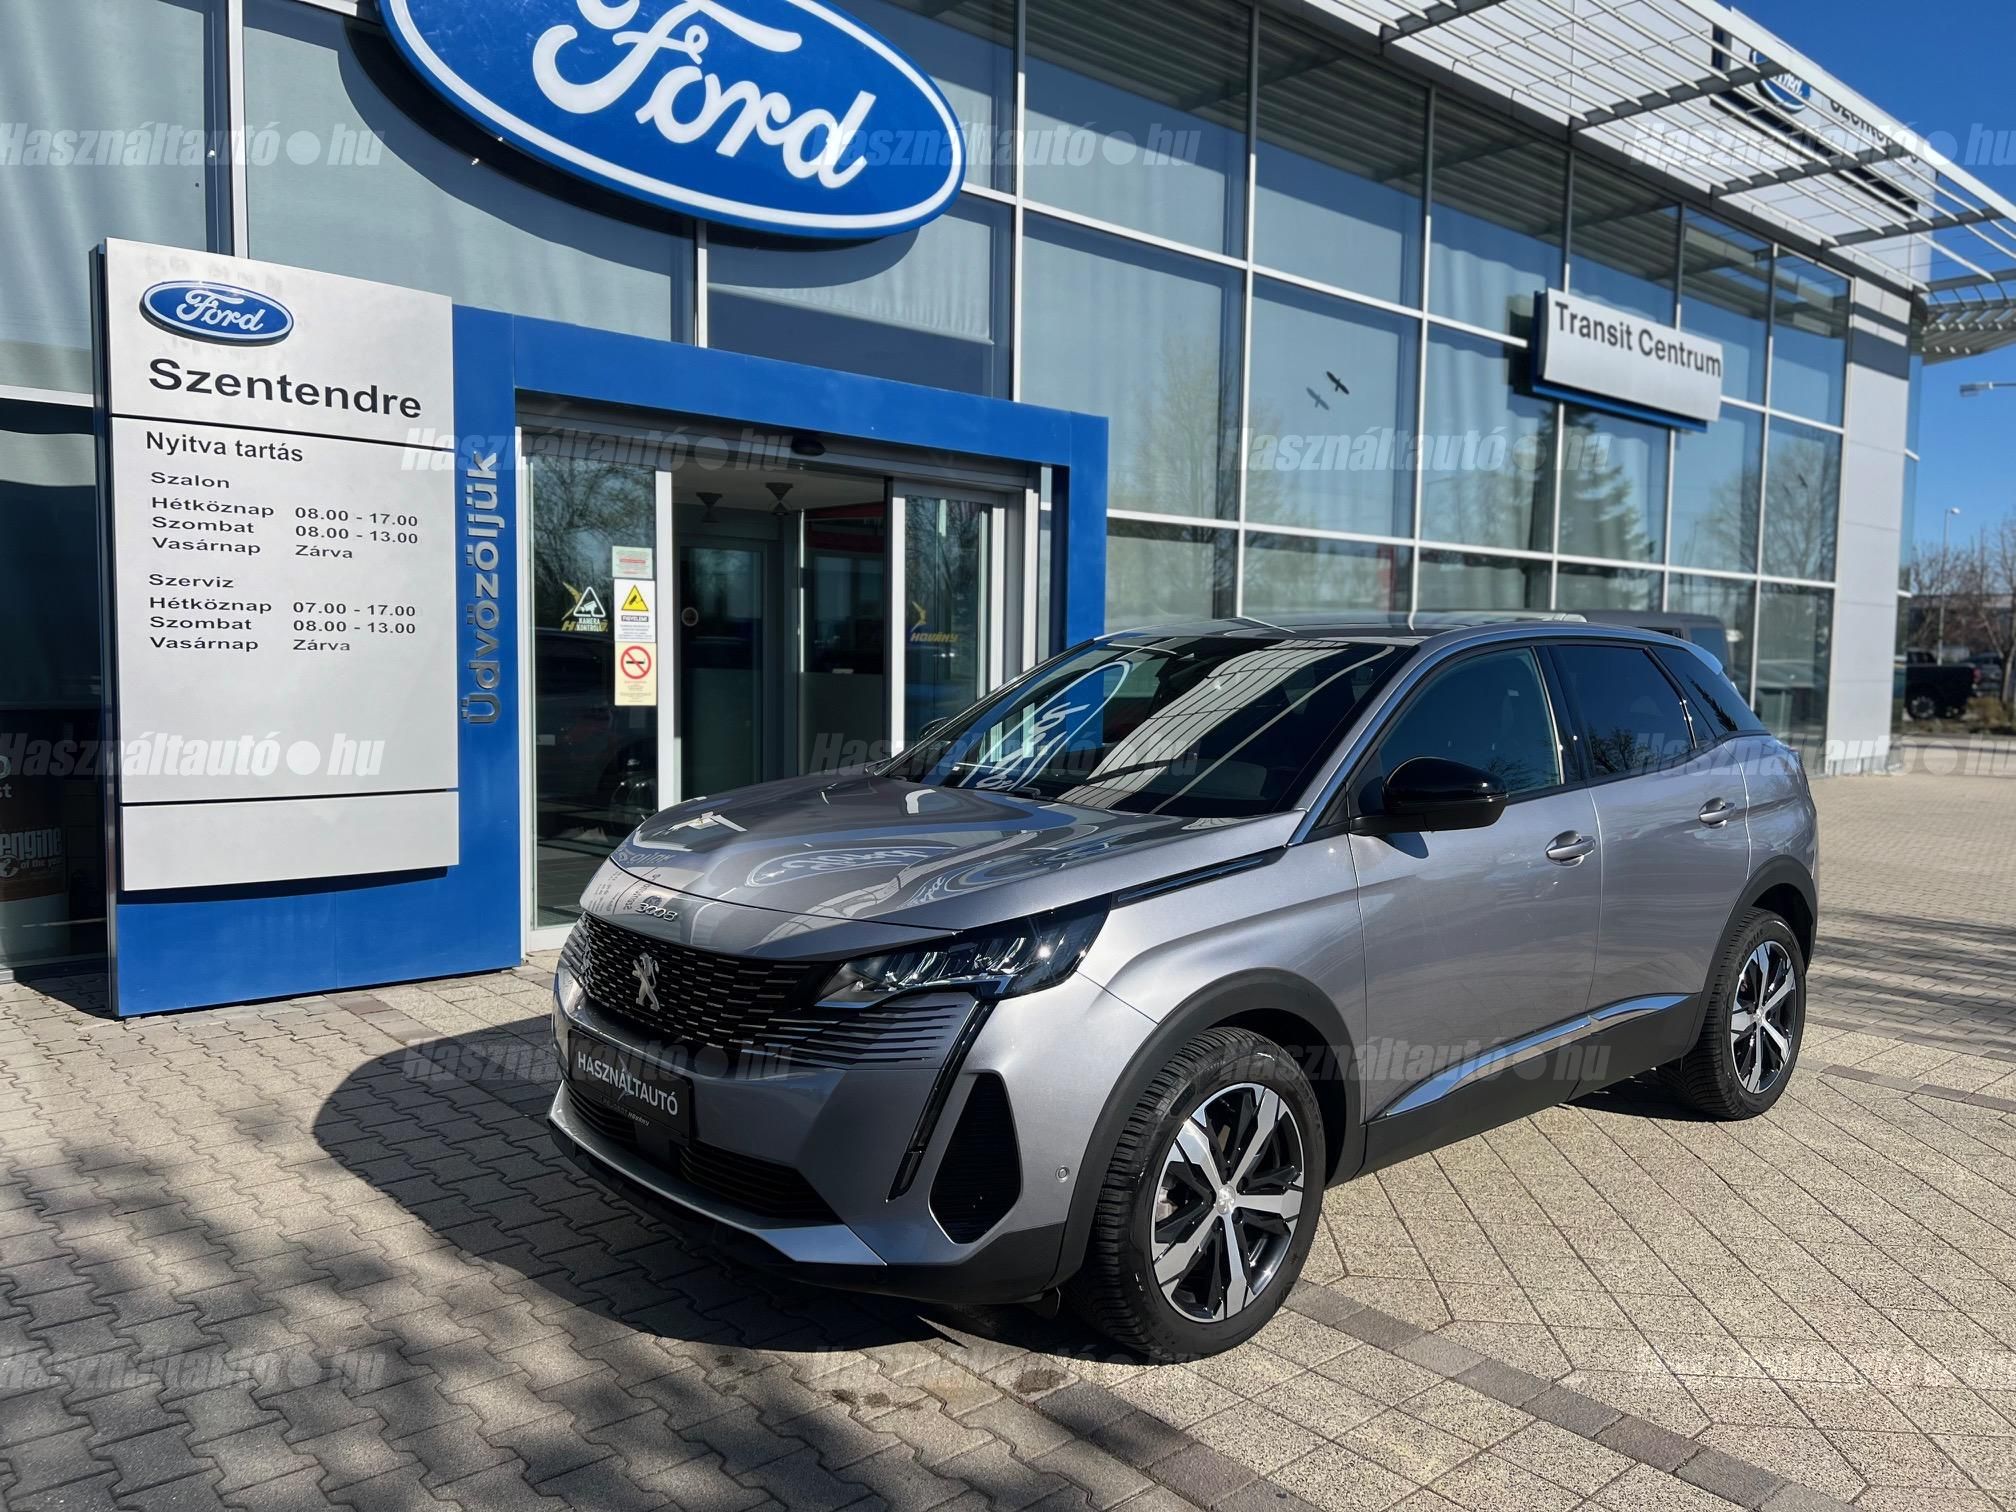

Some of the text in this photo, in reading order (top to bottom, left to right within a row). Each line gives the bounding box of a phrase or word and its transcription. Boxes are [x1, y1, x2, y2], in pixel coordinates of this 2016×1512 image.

[532, 0, 877, 189] Ford
[176, 289, 265, 332] Ford
[1554, 302, 1722, 378] Transit Centrum
[148, 358, 422, 419] Szentendre
[146, 431, 304, 462] Nyitva tartás
[150, 471, 230, 489] Szalon
[152, 497, 275, 518] Hétköznap
[295, 507, 349, 522] 08.00
[369, 512, 419, 527] 17.00
[151, 516, 255, 534] Szombat
[295, 525, 349, 540] 08.00
[369, 530, 419, 544] 13.00
[151, 536, 353, 559] Vasárnap Zárva
[149, 573, 234, 589] Szerviz
[462, 451, 504, 724] Üdvözöljük
[149, 597, 272, 614] Hétköznap
[293, 601, 347, 615] 07.00
[367, 604, 416, 617] 17.00
[150, 616, 252, 630] Szombat
[293, 620, 347, 632] 08.00
[367, 622, 416, 634] 13.00
[149, 637, 351, 653] Vasárnap Zárva
[635, 902, 678, 922] 3008
[577, 1050, 679, 1116] HASZNÁLTAUTÓ
